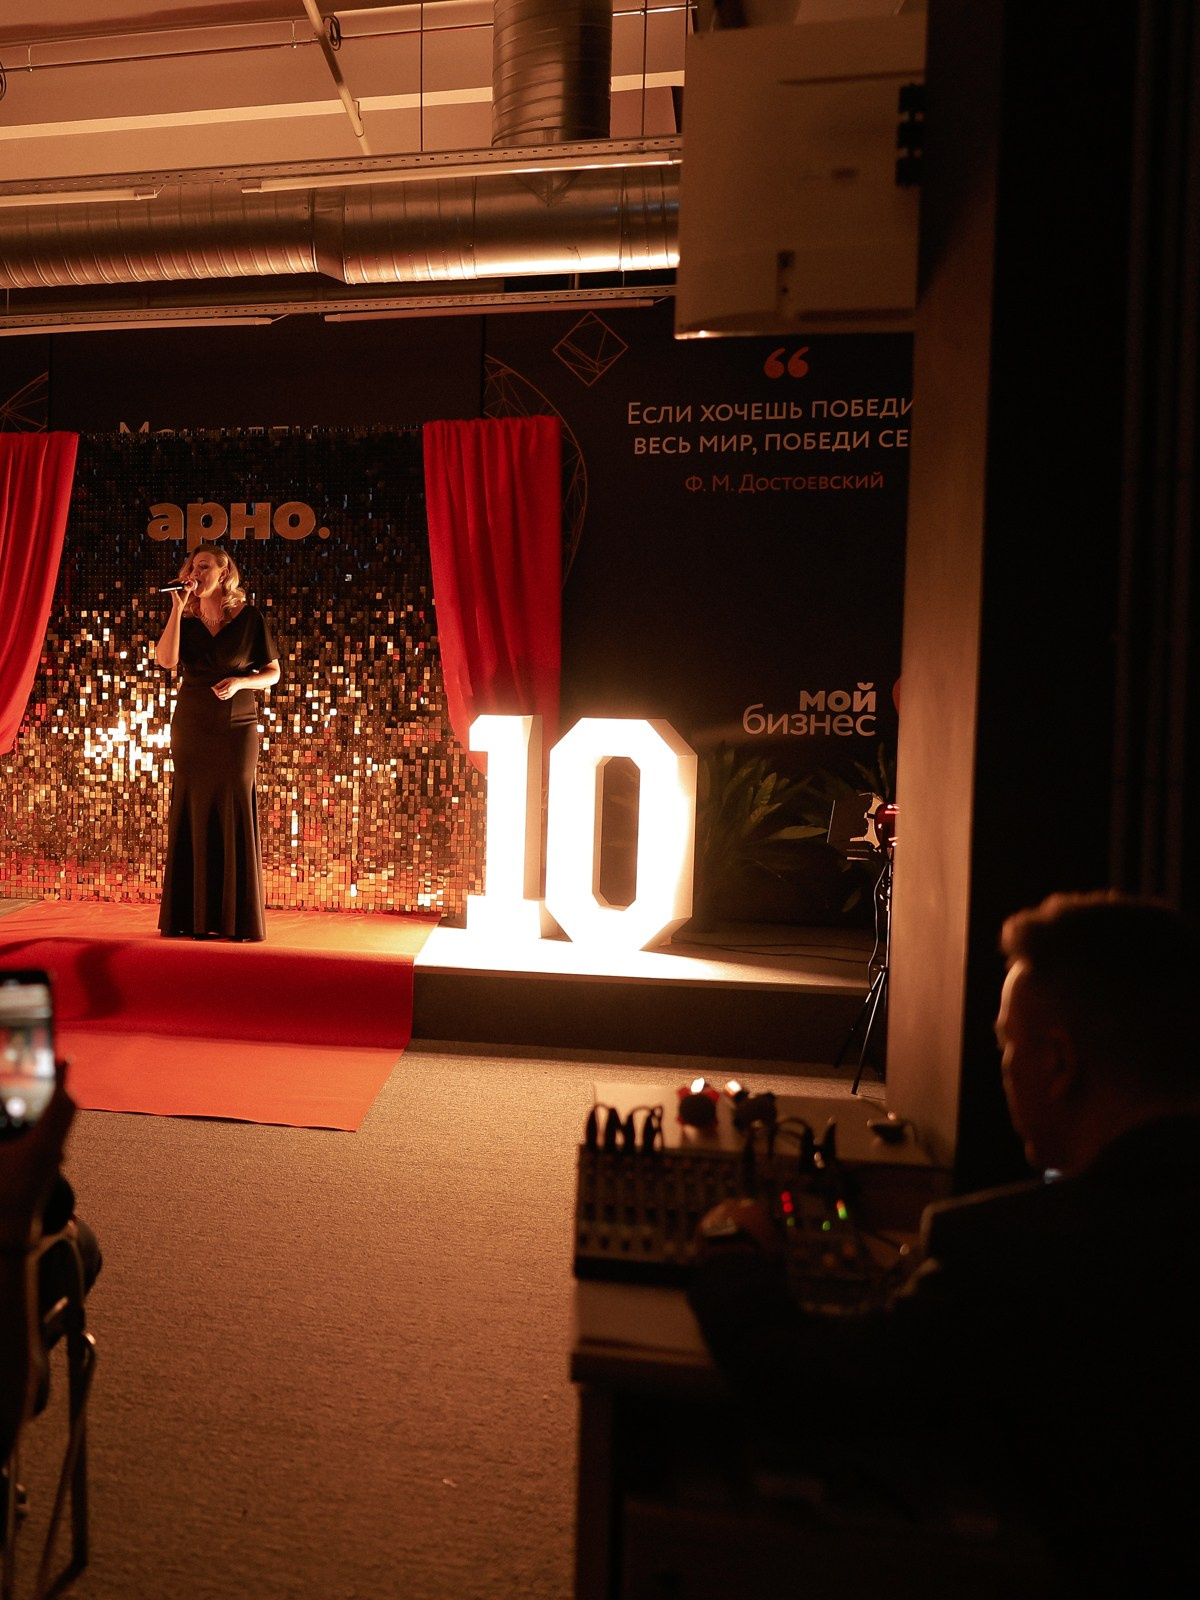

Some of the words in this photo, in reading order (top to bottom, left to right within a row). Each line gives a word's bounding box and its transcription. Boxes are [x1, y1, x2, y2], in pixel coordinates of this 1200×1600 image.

[699, 400, 804, 422] ХОЧЕШЬ
[633, 436, 692, 455] ВЕСЬ
[699, 433, 758, 455] МИР,
[764, 430, 870, 452] ПОБЕДИ
[684, 475, 706, 492] Ф.
[712, 474, 734, 491] М.
[147, 501, 331, 553] арно.
[799, 682, 877, 712] мой
[742, 703, 877, 737] бизнес
[466, 714, 698, 951] 10
